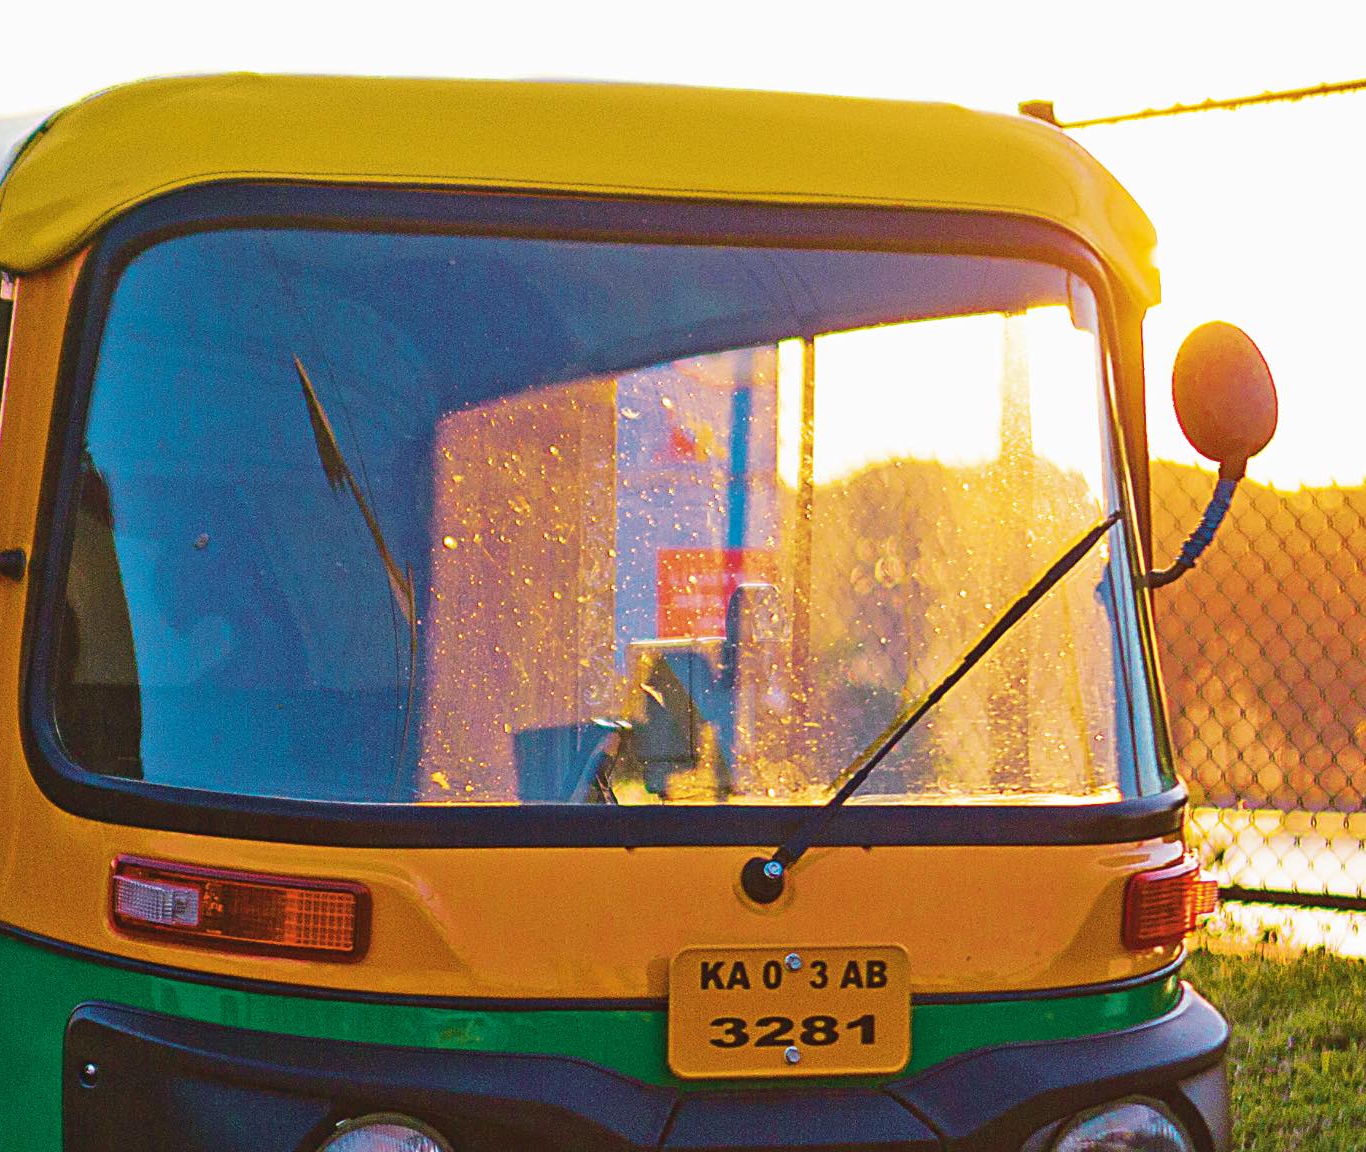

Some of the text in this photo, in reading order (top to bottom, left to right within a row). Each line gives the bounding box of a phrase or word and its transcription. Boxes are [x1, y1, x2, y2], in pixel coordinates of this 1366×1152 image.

[700, 961, 751, 990] KA
[840, 960, 888, 989] AB
[709, 1014, 876, 1048] 3281
